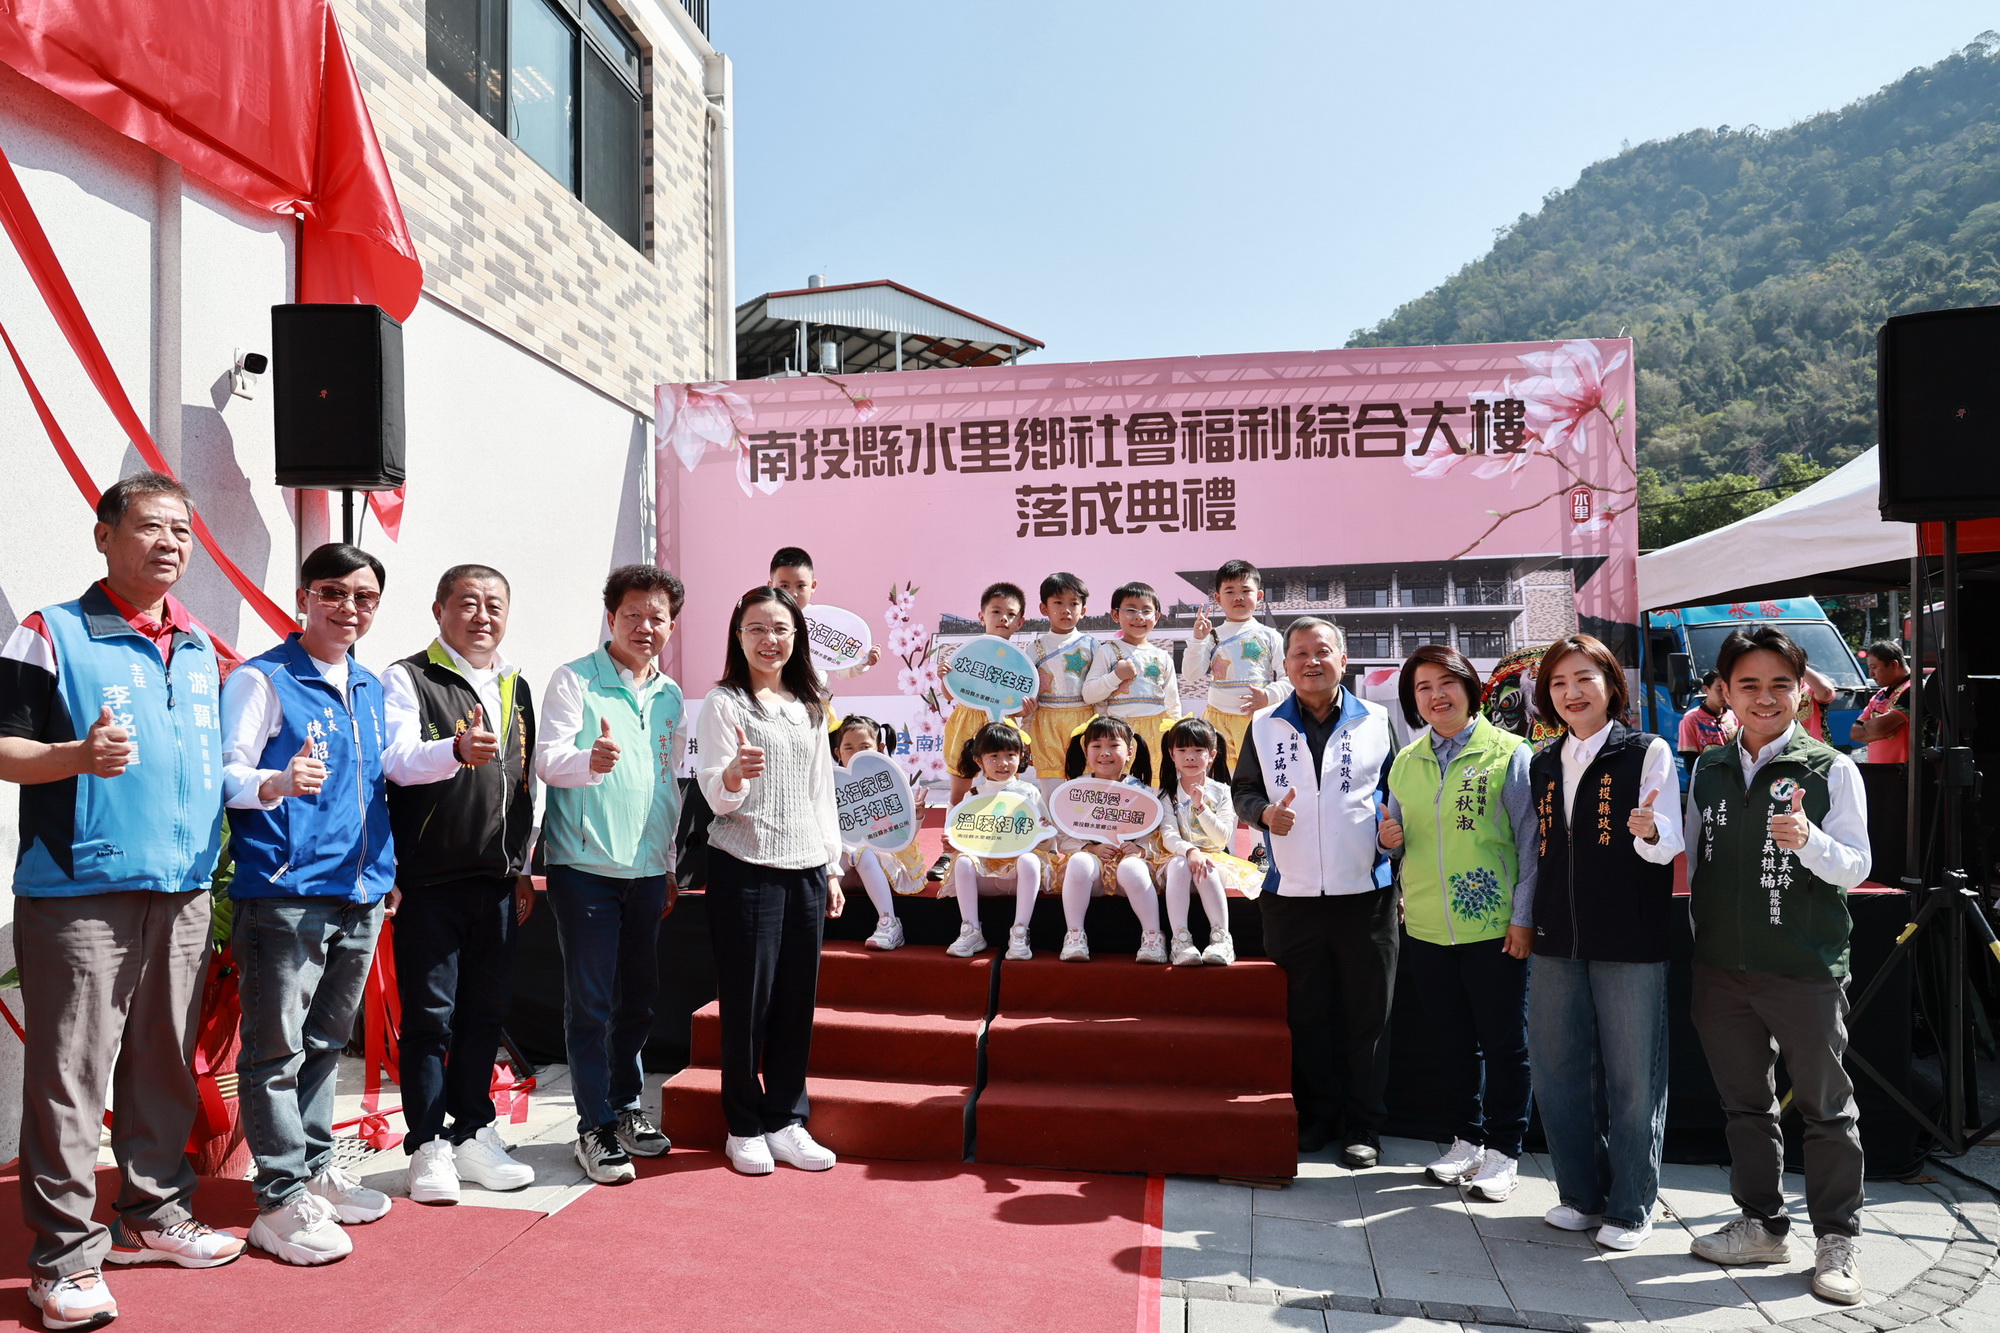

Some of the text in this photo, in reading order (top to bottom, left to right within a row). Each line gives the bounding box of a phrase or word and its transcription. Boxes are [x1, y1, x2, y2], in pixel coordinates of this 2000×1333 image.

[748, 399, 1527, 483] 南投縣水里鄉社會福利綜合大樓
[1015, 476, 1236, 538] 落成典禮
[1574, 493, 1589, 519] 水里
[129, 664, 147, 688] 主任
[955, 657, 1034, 694] 水里好生活
[960, 687, 1000, 705] 南投縣水里鄉公所
[102, 684, 142, 766] 李銘
[323, 707, 339, 732] 村長
[428, 722, 440, 740] URB
[306, 719, 333, 776] 陳昭
[1289, 732, 1299, 762] 副縣長
[1340, 729, 1353, 794] 南投縣政府
[1274, 742, 1289, 788] 王瑞德
[839, 793, 904, 832] 心手相連
[1092, 806, 1146, 826] 希望延續
[1455, 779, 1476, 831] 王秋淑
[1597, 773, 1613, 846] 南投縣政府
[1716, 799, 1728, 826] 主任
[867, 820, 910, 840] 南投縣水里鄉公所
[956, 812, 1034, 835] 溫暖相伴
[957, 833, 1002, 841] 南投縣水里鄉公所
[1073, 821, 1118, 831] 南投縣水里鄉公所
[1769, 889, 1783, 926] 服務團隊
